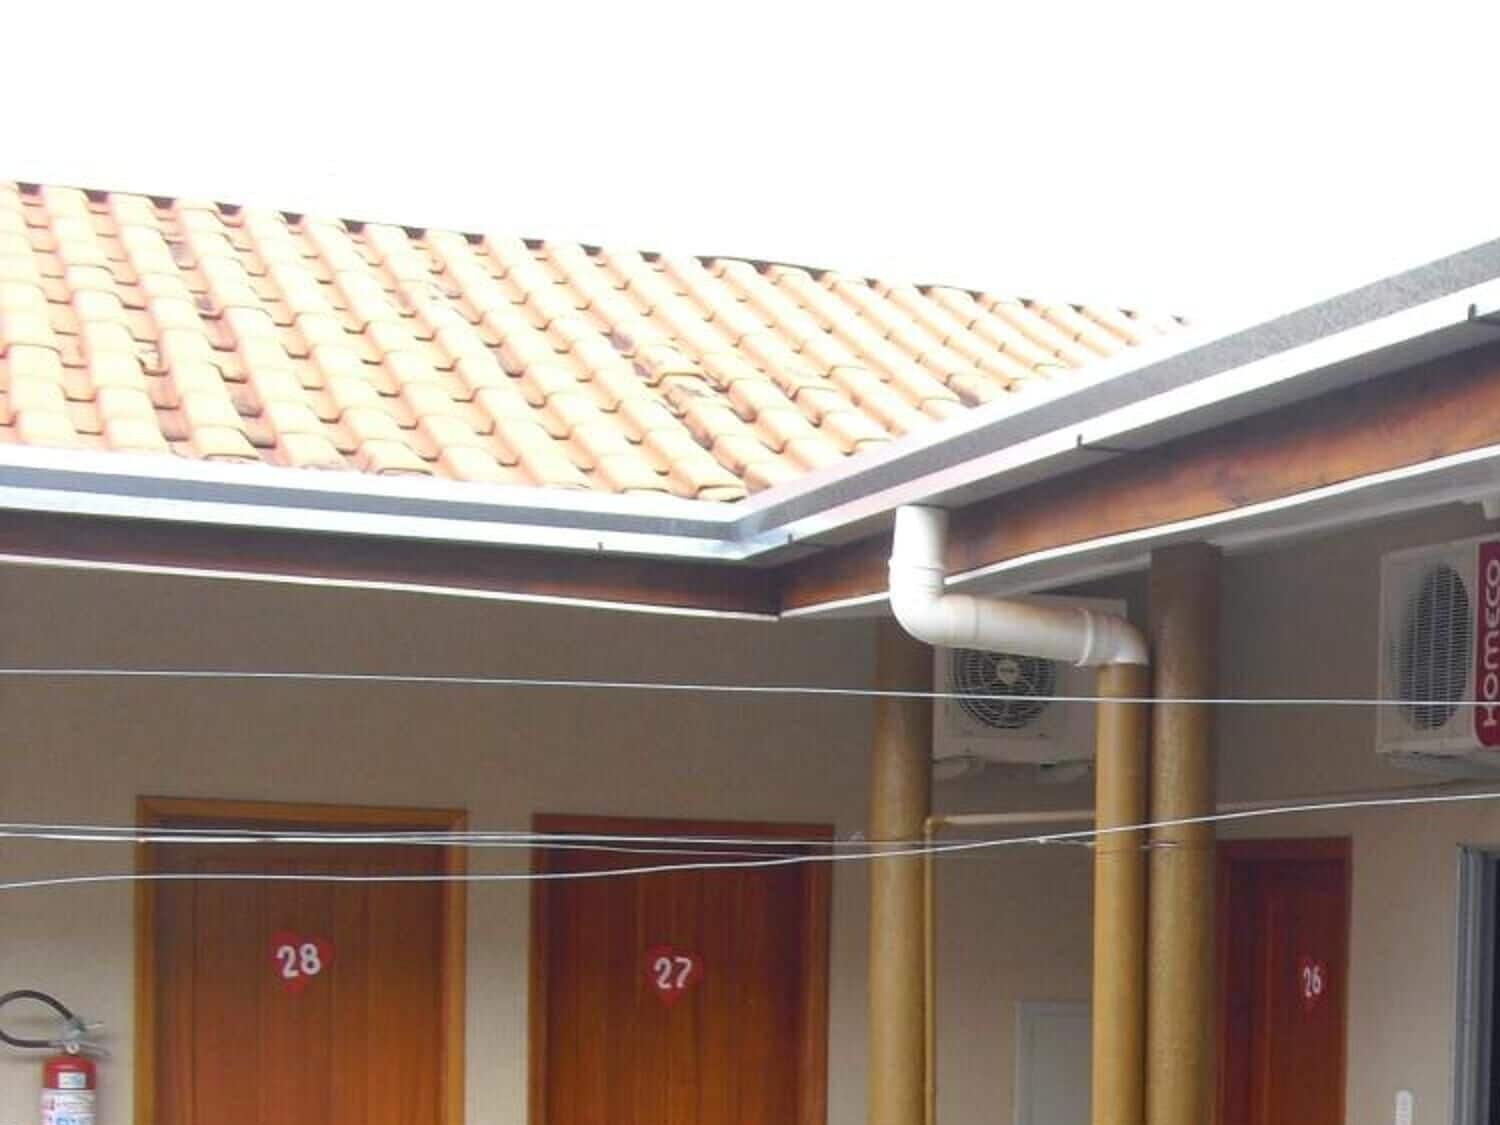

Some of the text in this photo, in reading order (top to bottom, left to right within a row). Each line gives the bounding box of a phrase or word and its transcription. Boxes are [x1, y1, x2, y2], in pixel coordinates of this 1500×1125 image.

[276, 943, 321, 978] 28
[653, 956, 693, 989] 27
[1303, 965, 1322, 998] 26
